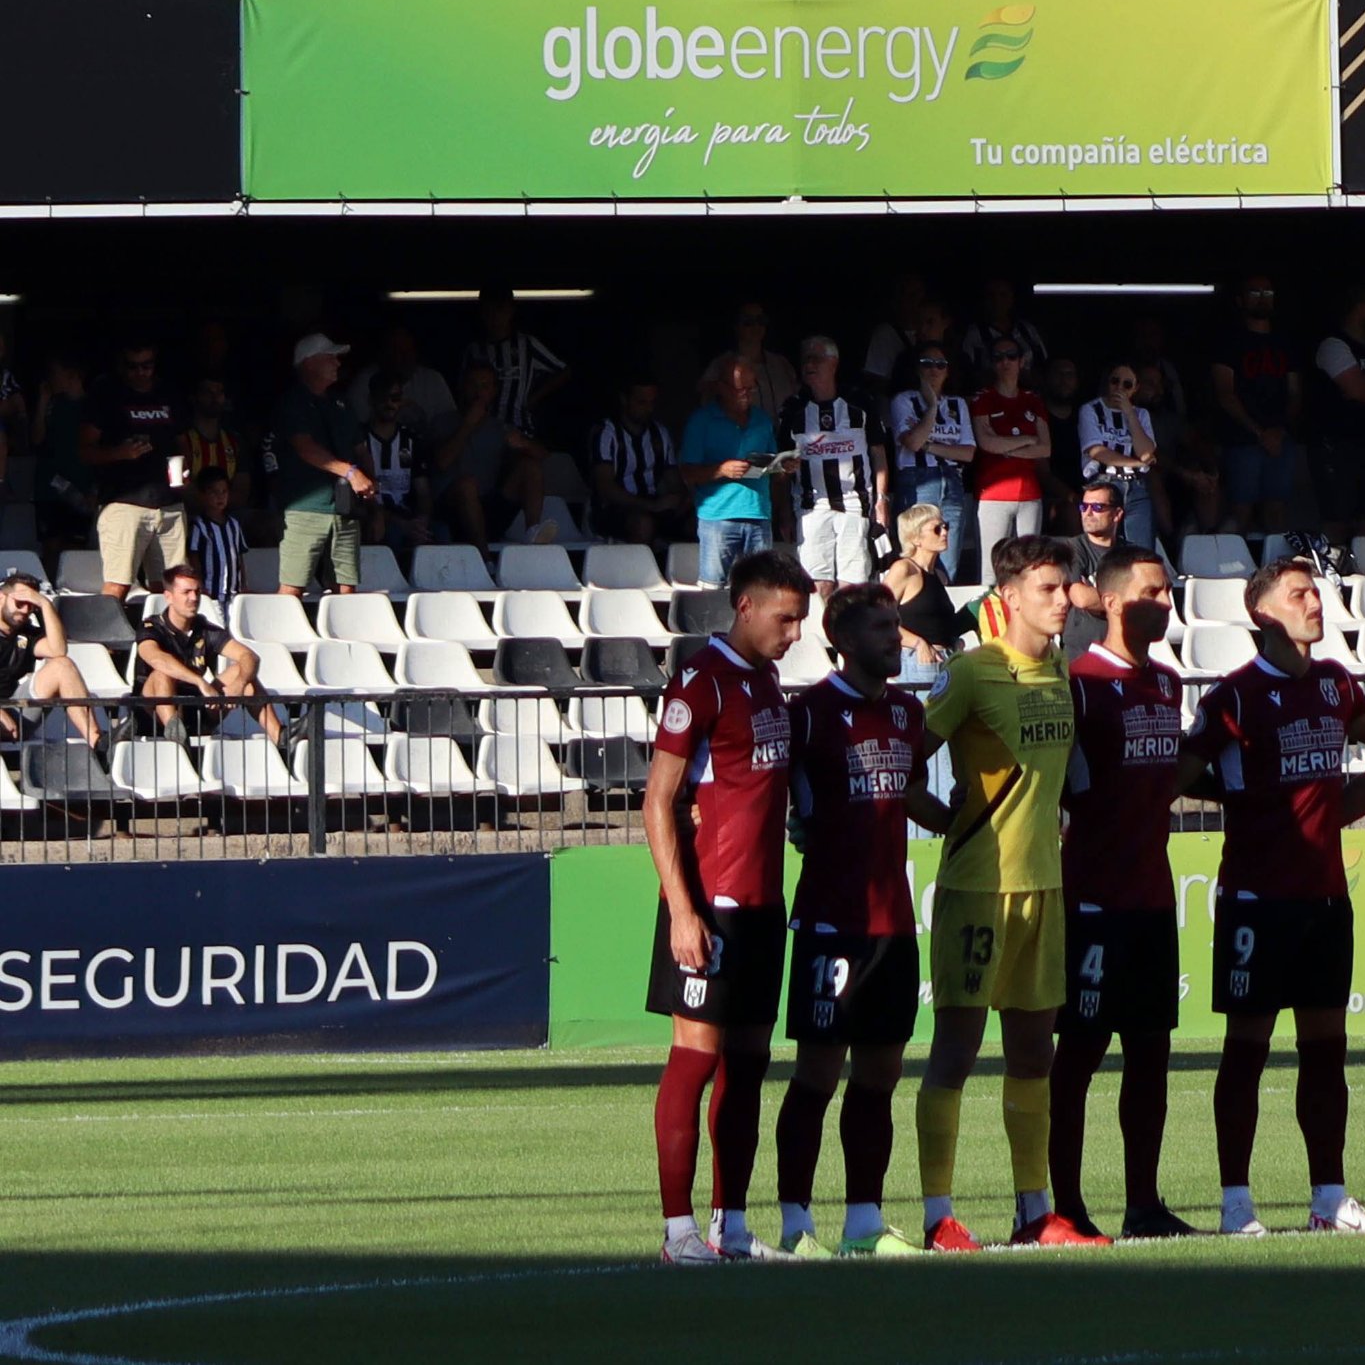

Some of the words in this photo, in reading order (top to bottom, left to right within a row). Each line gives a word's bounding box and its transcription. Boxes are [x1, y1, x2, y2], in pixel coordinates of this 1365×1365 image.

[704, 121, 791, 166] para
[793, 97, 871, 153] todos
[970, 138, 1003, 165] Tu
[1010, 135, 1141, 172] compañía
[1149, 135, 1269, 165] eléctrica
[960, 924, 995, 966] 13
[1081, 944, 1105, 985] 4
[1235, 926, 1255, 964] 9
[0, 940, 438, 1012] SEGURIDAD
